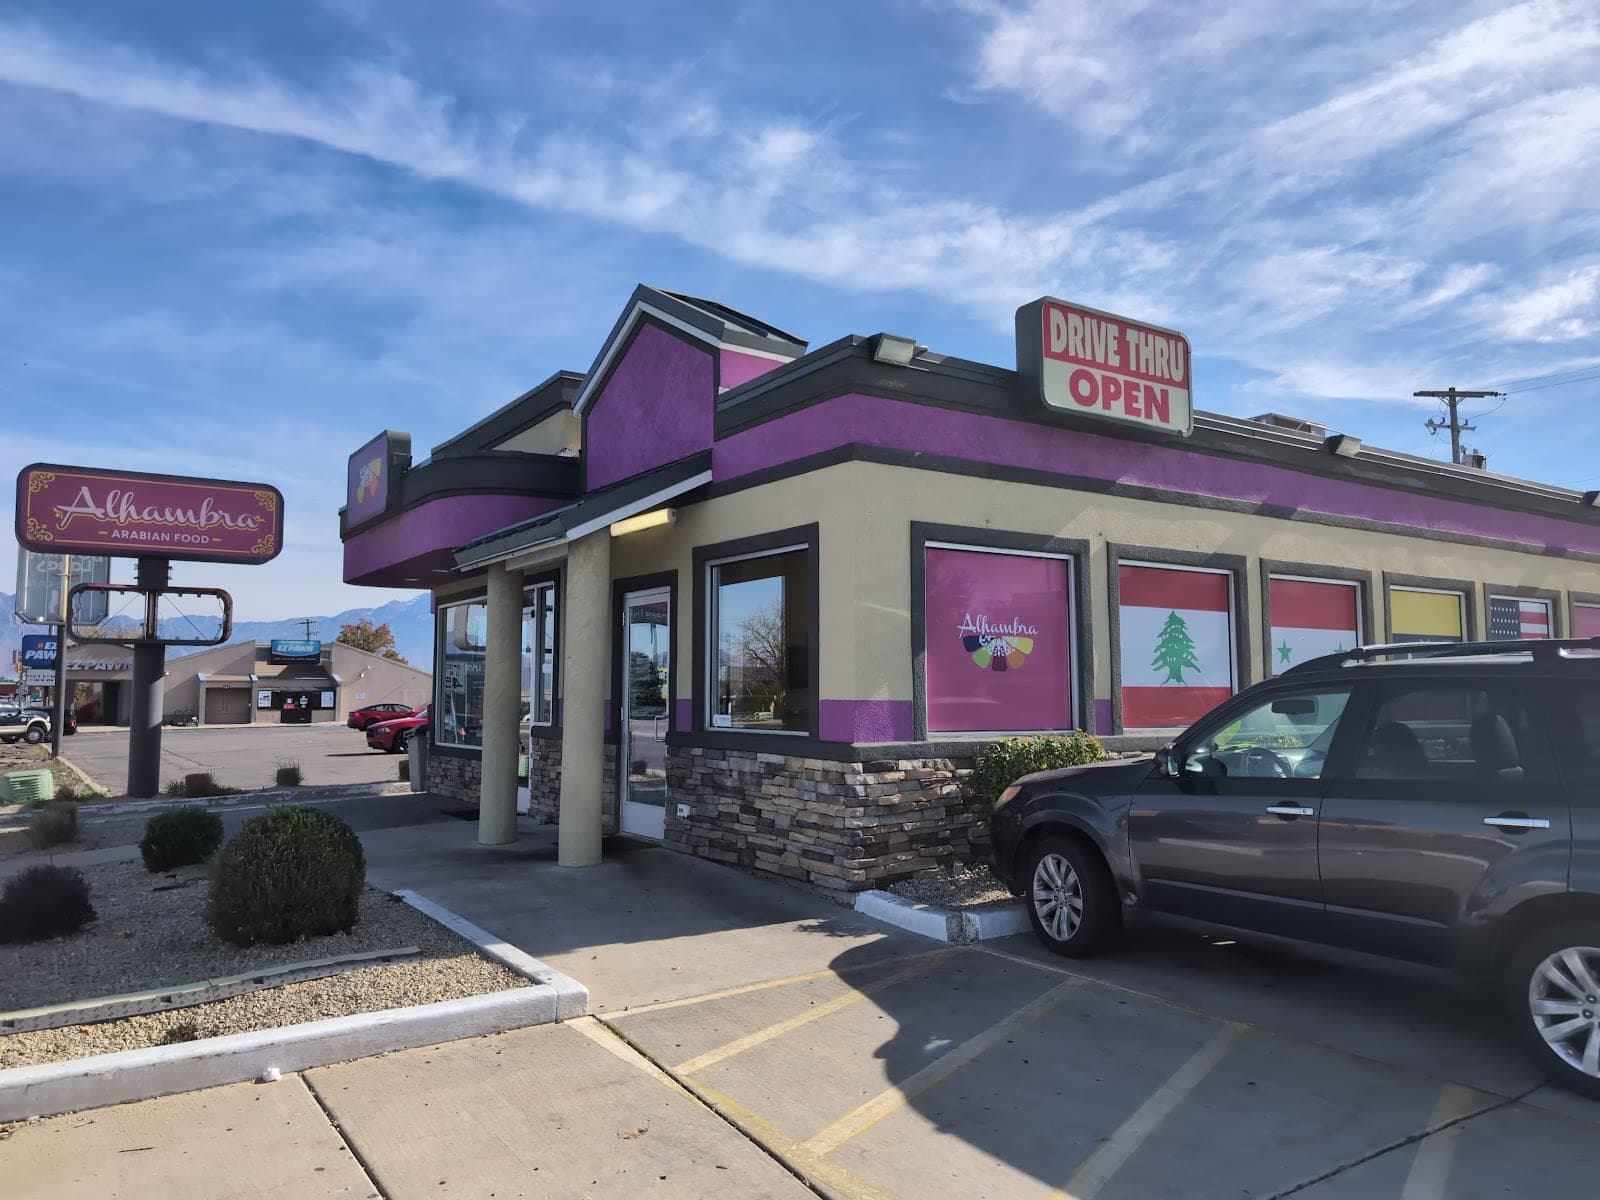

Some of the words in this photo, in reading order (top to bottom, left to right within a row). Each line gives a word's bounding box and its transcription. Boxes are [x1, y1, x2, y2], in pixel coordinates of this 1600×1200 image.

[1049, 308, 1121, 367] DRIVE
[1126, 328, 1184, 382] THRU
[1068, 368, 1170, 424] OPEN
[56, 486, 260, 529] Alhambra
[111, 529, 170, 542] ARABIAN
[174, 533, 209, 544] FOOD
[956, 613, 1038, 639] Alhambra
[25, 650, 57, 660] PAW
[44, 641, 57, 650] EZ
